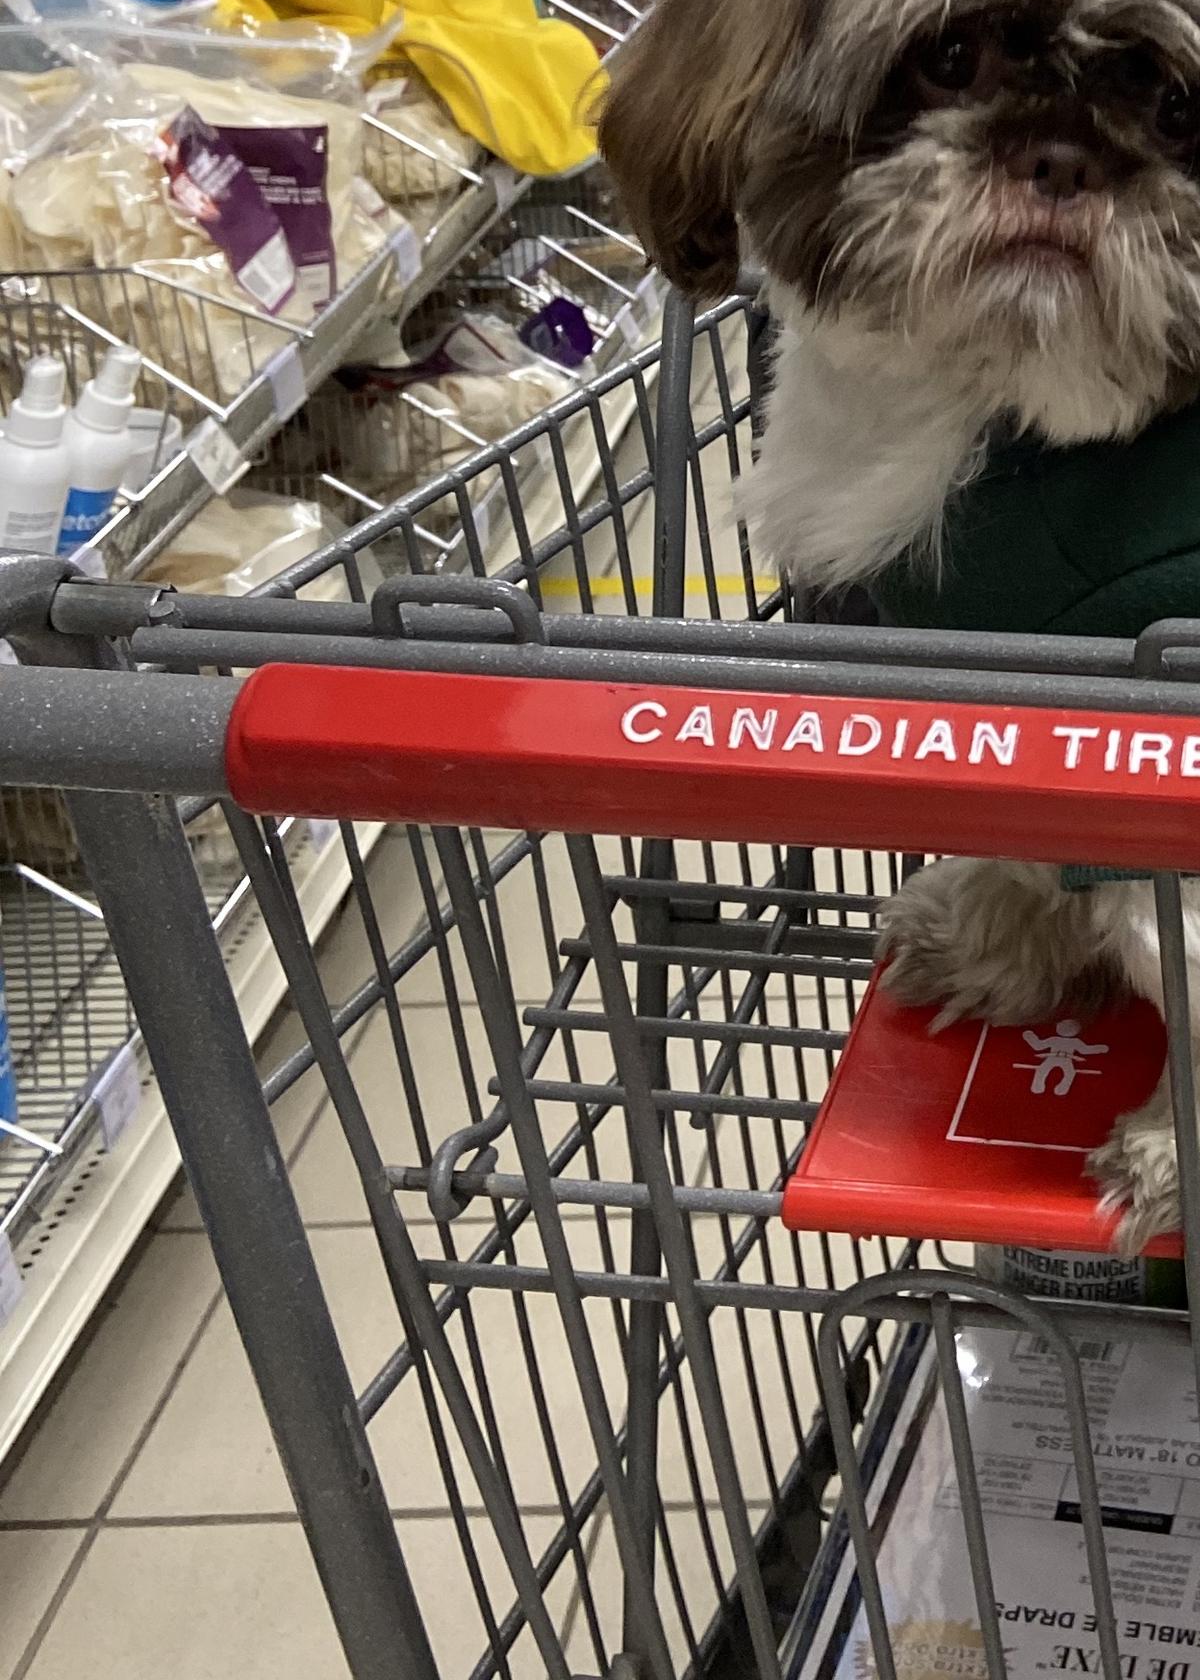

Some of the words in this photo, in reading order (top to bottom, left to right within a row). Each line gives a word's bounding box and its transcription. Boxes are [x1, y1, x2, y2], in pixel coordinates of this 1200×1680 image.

[621, 700, 1019, 767] CANADIAN
[1003, 1245, 1070, 1277] EXTREME
[1073, 1257, 1140, 1280] DANGER
[1034, 1435, 1145, 1460] MATTESS
[1051, 1645, 1138, 1679] LXE
